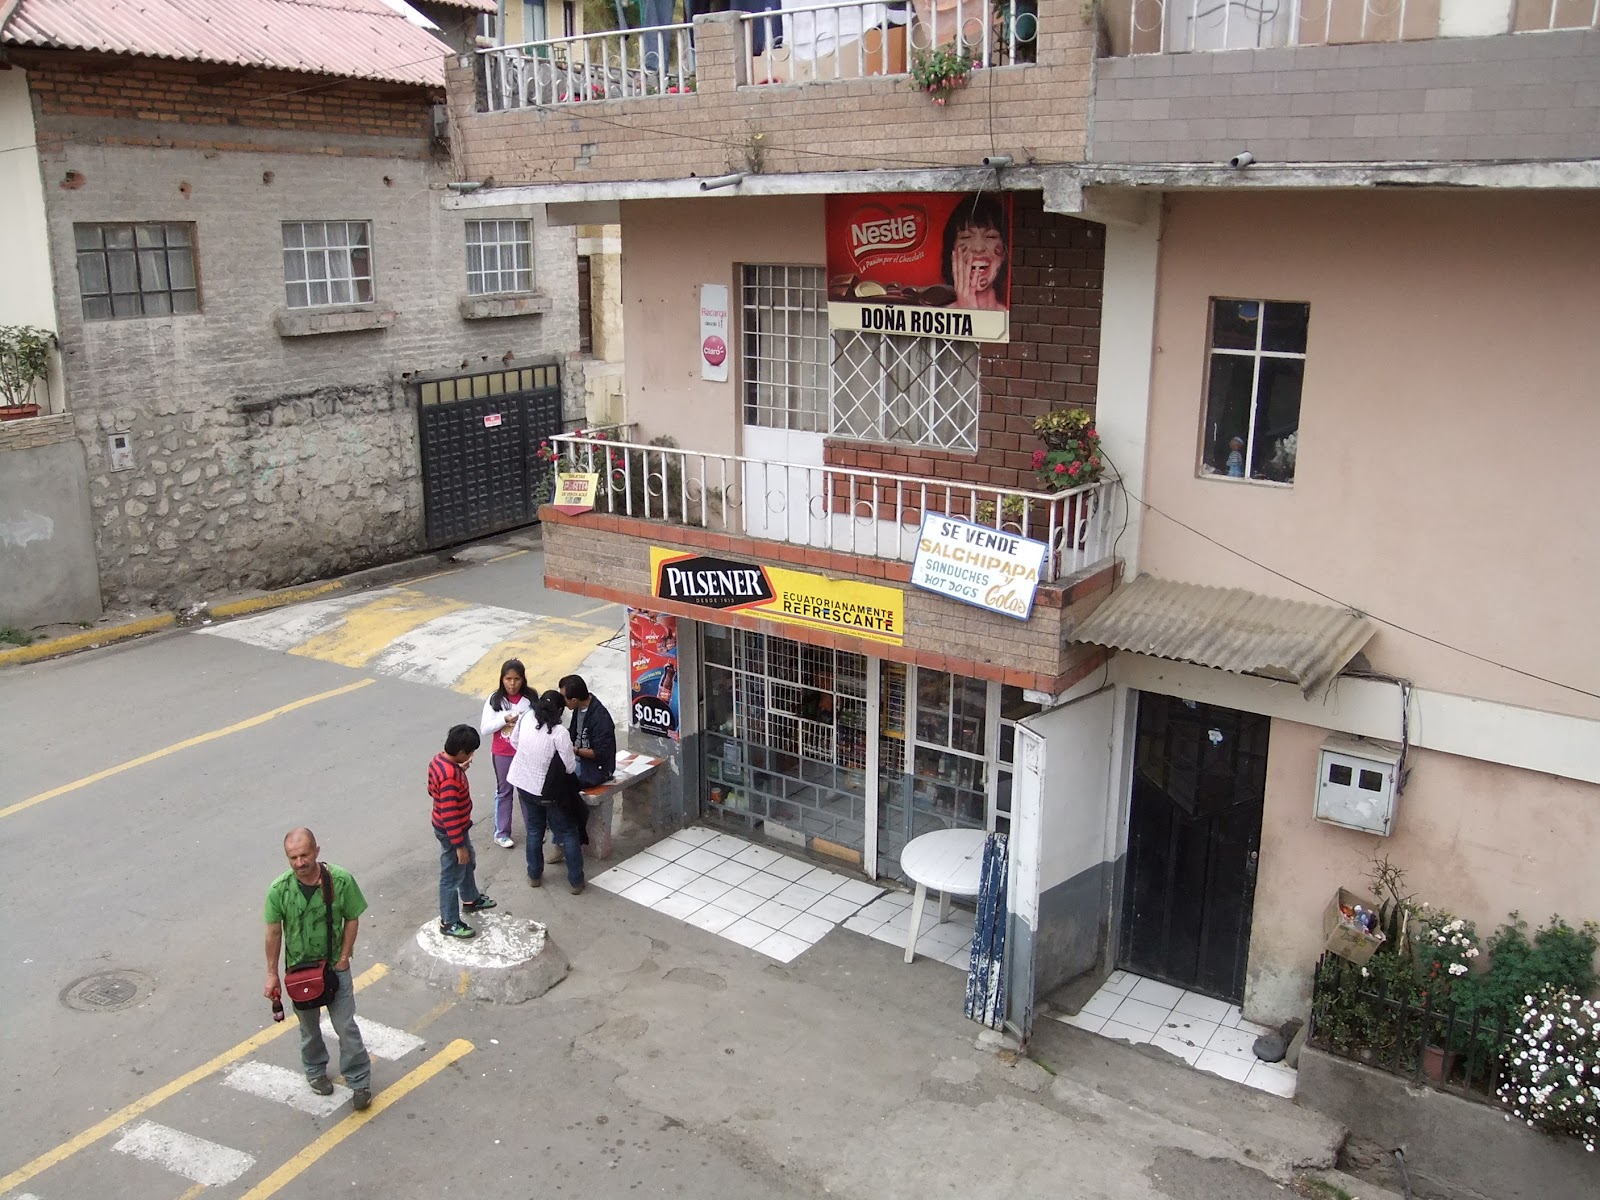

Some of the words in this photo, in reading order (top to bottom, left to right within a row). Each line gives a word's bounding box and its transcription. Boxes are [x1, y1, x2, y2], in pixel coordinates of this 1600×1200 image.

[851, 214, 917, 247] Nestlé
[883, 257, 892, 265] por
[861, 304, 906, 332] DOÑA
[910, 310, 973, 337] ROSITA
[703, 346, 723, 356] Claro
[941, 521, 962, 540] SE
[965, 527, 1020, 556] VENDE
[919, 537, 1038, 583] SALCHIPAPA
[925, 558, 990, 587] SANDUCHES
[666, 567, 763, 597] PILSENER
[924, 573, 947, 588] HOT
[948, 581, 979, 599] DOGS
[783, 591, 894, 620] ECUATORIANAMENTE
[984, 584, 1027, 614] Colas
[783, 600, 894, 632] REFRESCANTE
[635, 702, 671, 727] $0.50
